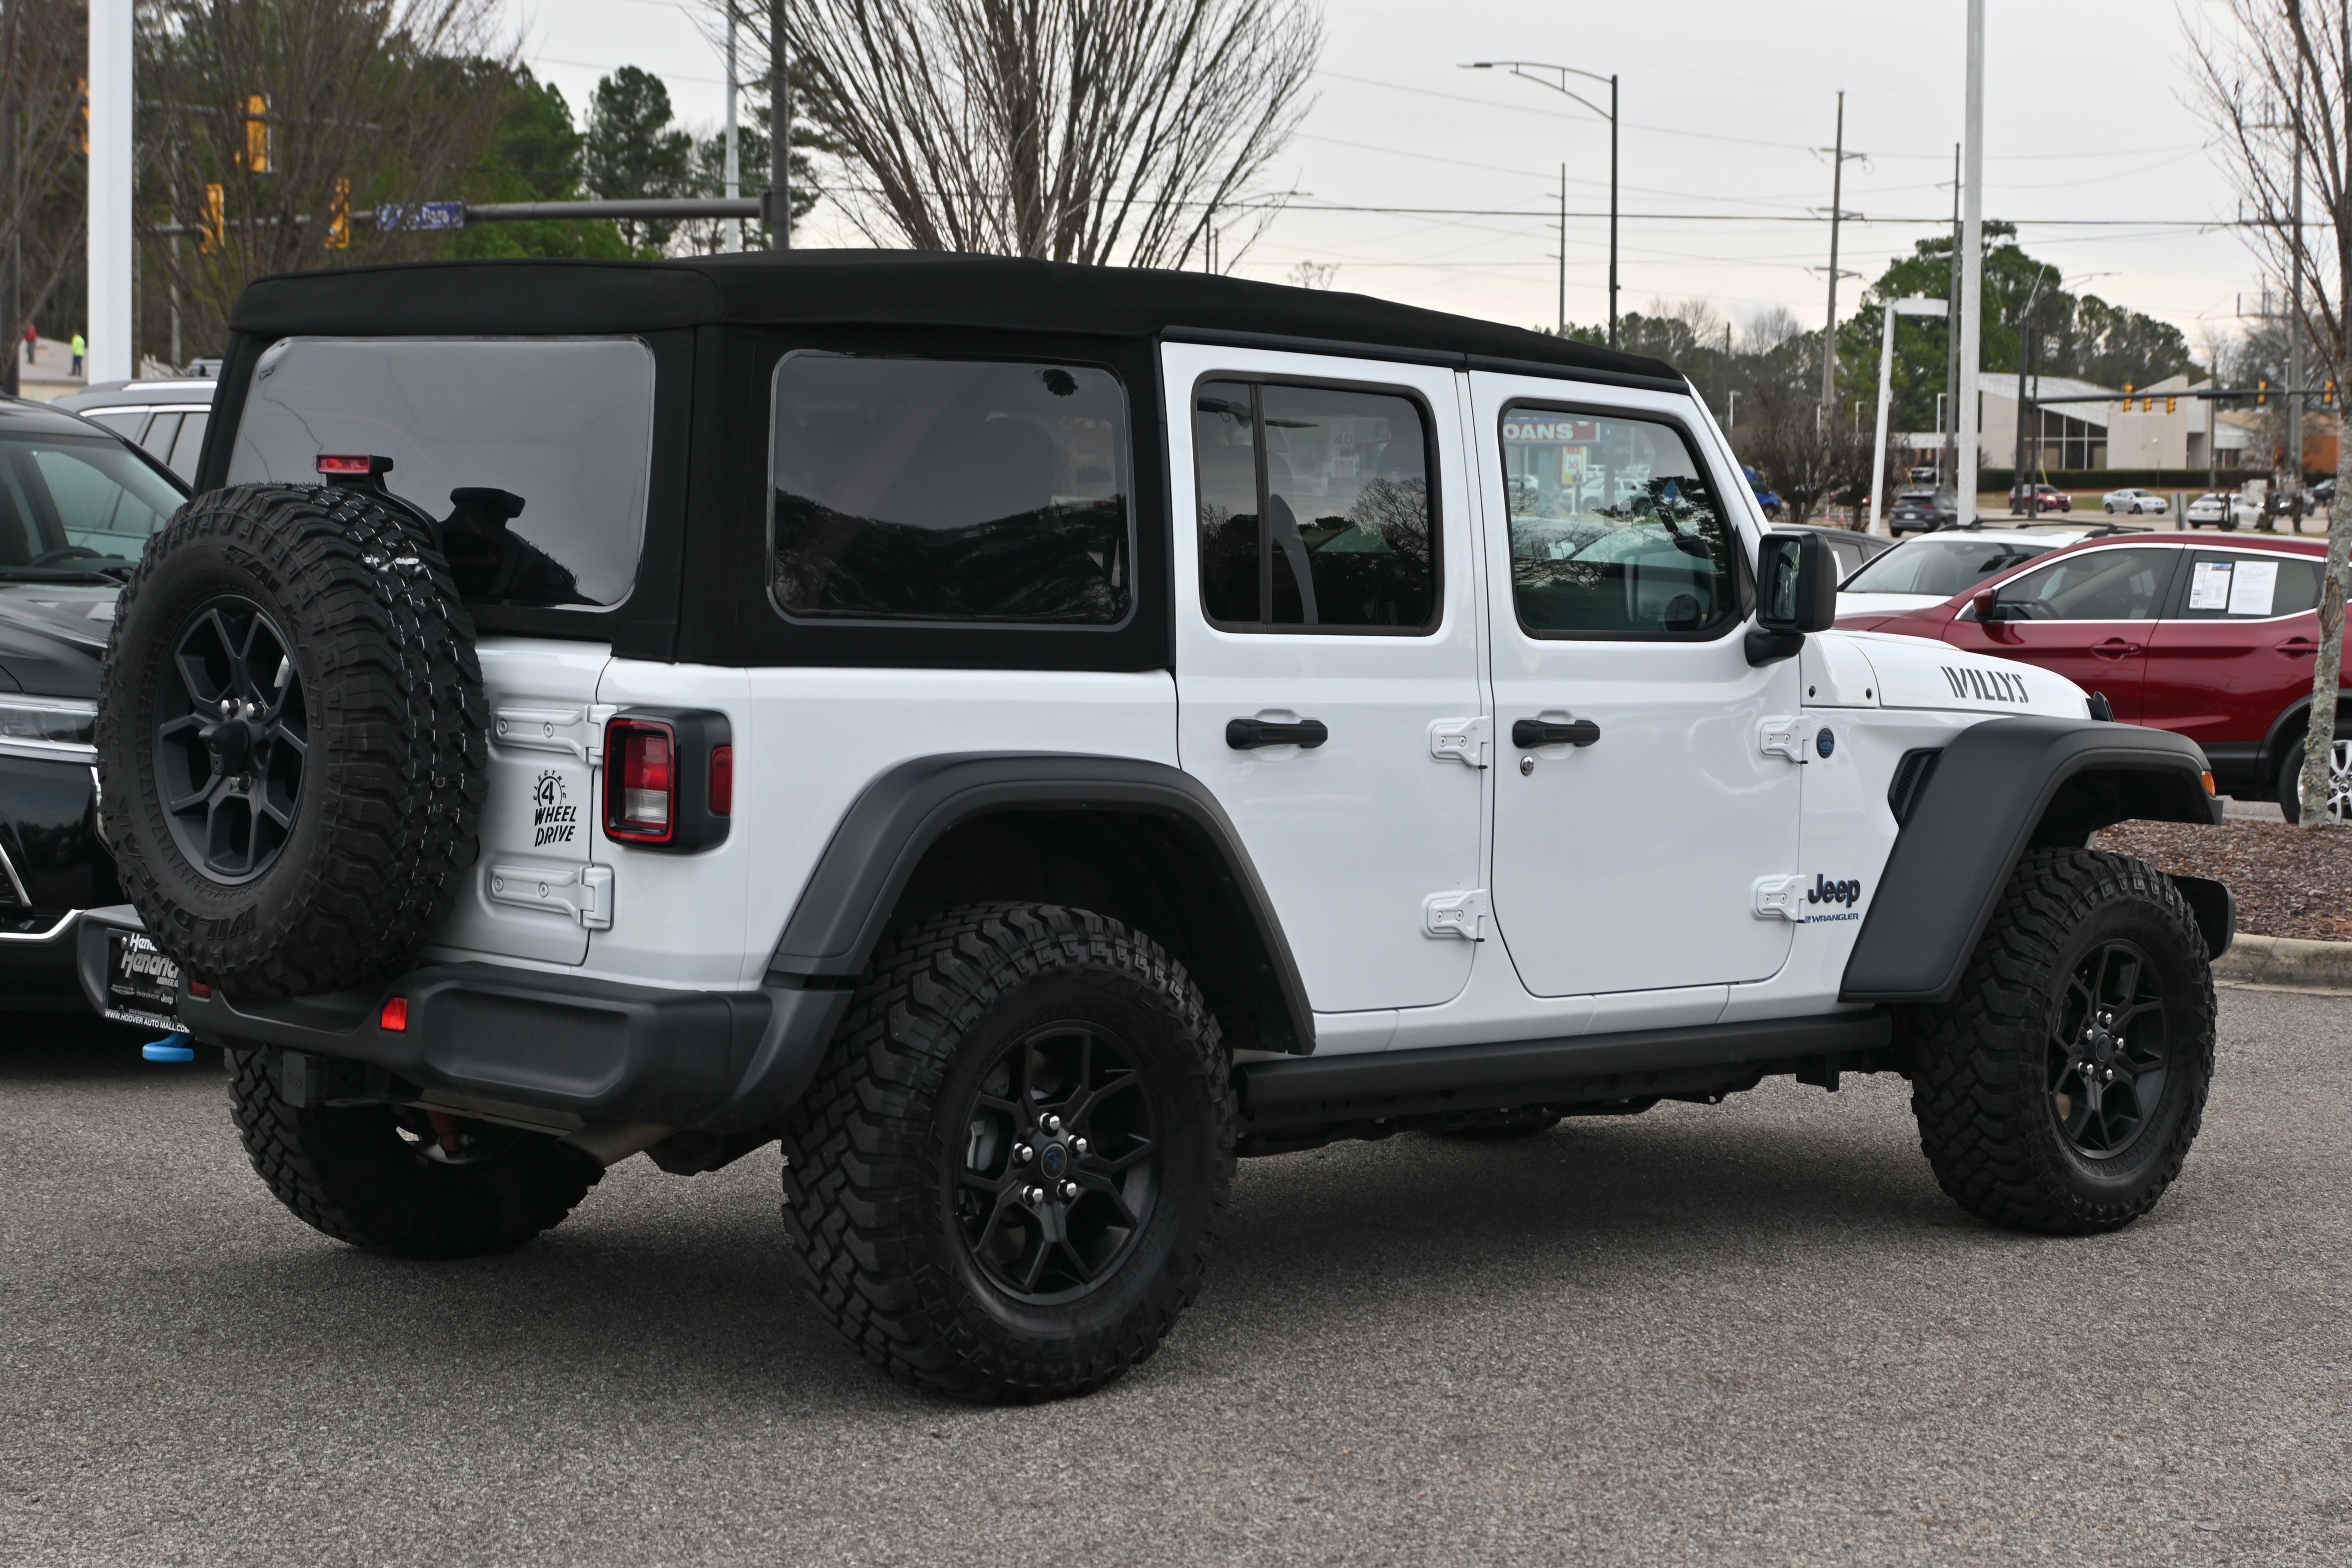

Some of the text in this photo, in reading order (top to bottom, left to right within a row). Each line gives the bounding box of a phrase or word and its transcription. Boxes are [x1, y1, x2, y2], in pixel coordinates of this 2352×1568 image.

[1334, 434, 1353, 444] 40
[1940, 666, 2029, 703] WILLYS
[534, 770, 566, 801] ELECTRIC
[542, 781, 554, 805] 4
[534, 806, 577, 826] WHEEL
[534, 825, 575, 847] DRIVE
[1808, 874, 1860, 908] Jeep
[1812, 913, 1859, 923] WRANGLER
[136, 991, 160, 1000] DODGE
[161, 994, 174, 1005] Jeep
[106, 1010, 190, 1033] WWW.HOOVER AUTO MALL.COM
